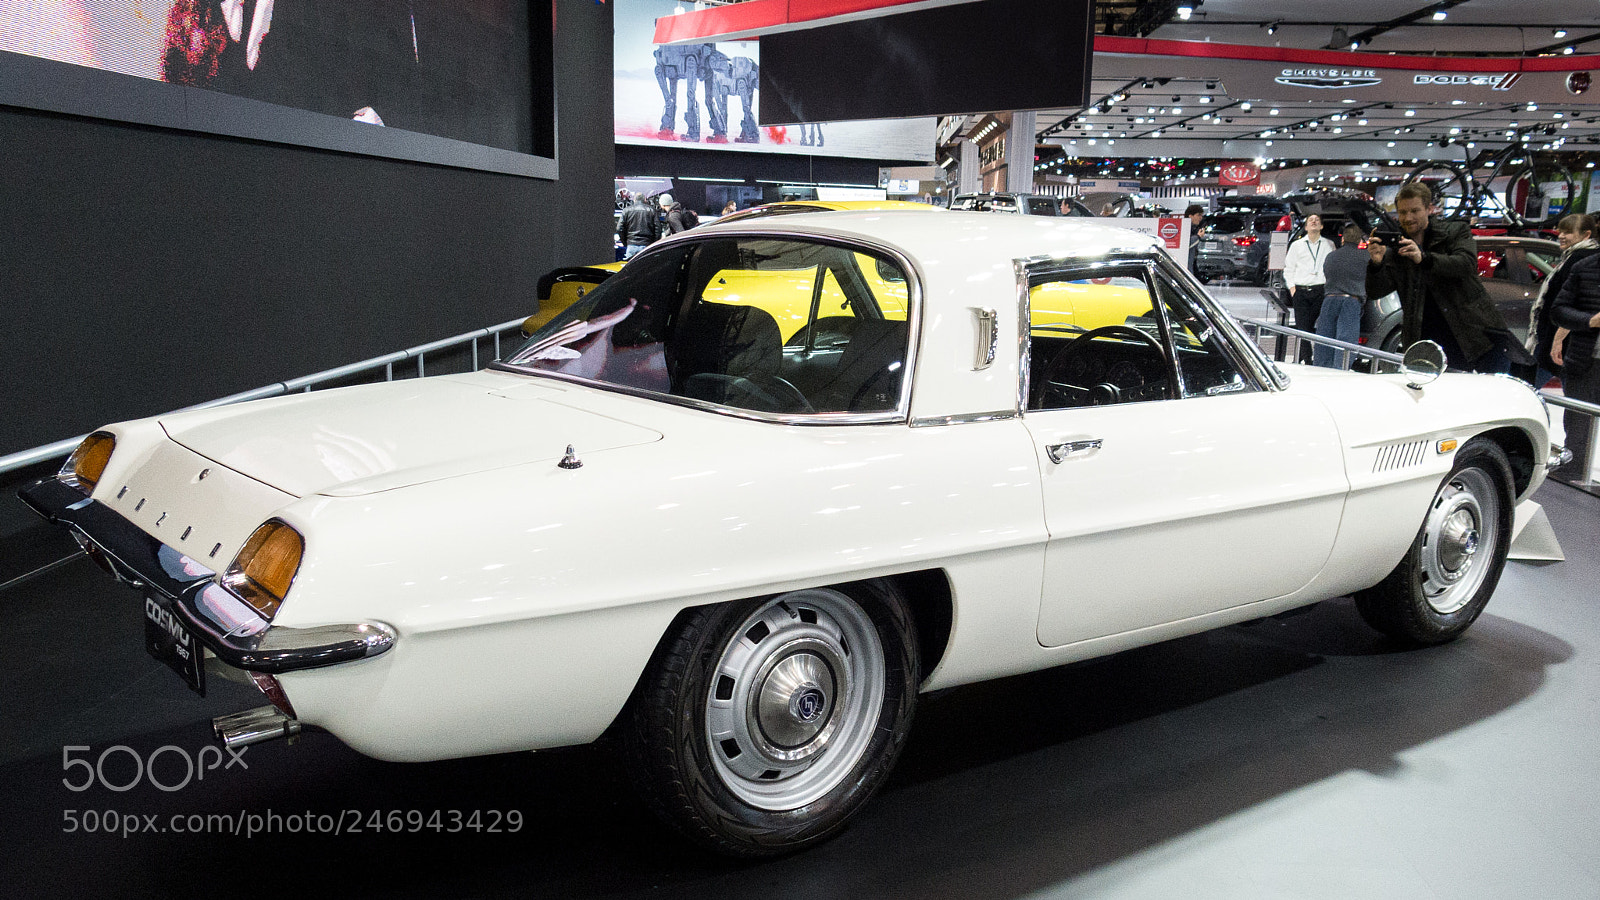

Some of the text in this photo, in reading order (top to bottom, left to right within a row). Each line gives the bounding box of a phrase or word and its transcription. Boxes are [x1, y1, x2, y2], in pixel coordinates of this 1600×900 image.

[1281, 68, 1376, 77] CHRYSLER
[1413, 75, 1504, 85] DODGE
[1229, 168, 1252, 179] KIA
[175, 643, 190, 660] 1967
